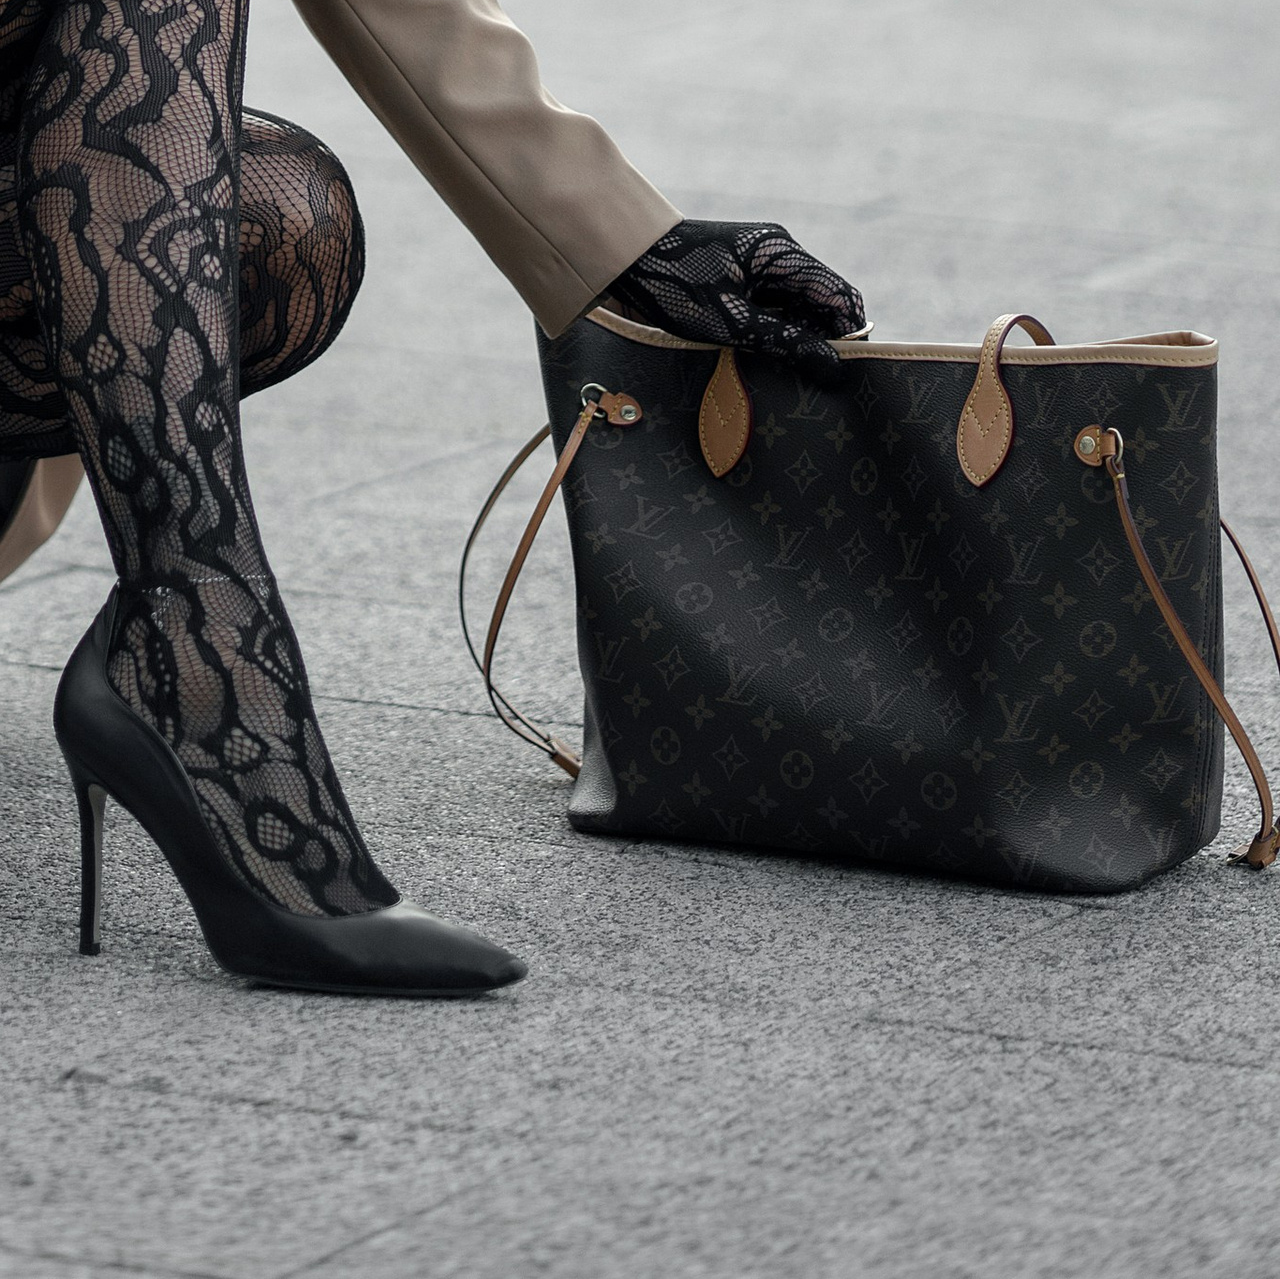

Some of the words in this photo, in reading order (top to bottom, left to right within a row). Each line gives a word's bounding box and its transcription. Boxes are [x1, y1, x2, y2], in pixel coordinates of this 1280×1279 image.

[1156, 382, 1203, 432] LV
[621, 494, 677, 539] LV
[764, 524, 814, 570] LV
[1003, 534, 1046, 584] LV
[716, 655, 768, 706] LV
[856, 681, 910, 729] LV
[1142, 675, 1188, 725] LV
[993, 693, 1043, 742] LV
